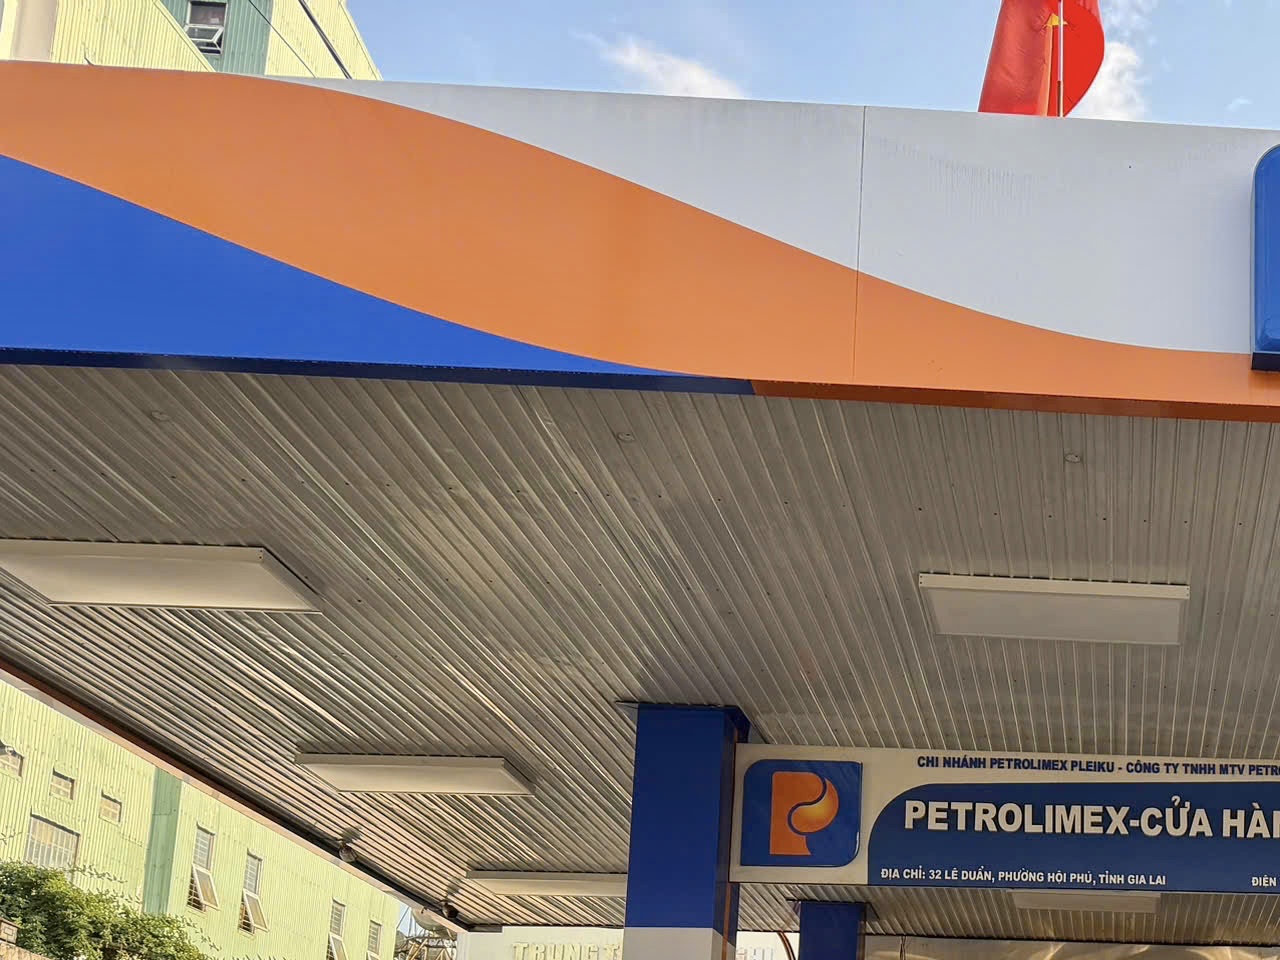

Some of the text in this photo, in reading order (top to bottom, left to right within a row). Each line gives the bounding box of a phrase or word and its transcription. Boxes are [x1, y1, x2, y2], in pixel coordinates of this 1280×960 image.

[918, 755, 939, 768] CHI
[943, 754, 986, 769] NHÁNH
[990, 758, 1067, 772] PETROLIMEX
[1071, 760, 1115, 773] PLEIKU
[1126, 759, 1160, 774] CÔNG
[1164, 763, 1179, 774] TY
[1183, 763, 1215, 775] TNHH
[1219, 764, 1245, 775] MTV
[904, 795, 1213, 838] PETROLIMEX-CỬA
[881, 865, 1166, 886] ĐỊA CHỈ: 32 LÊ DUẨN, PHƯỜNG HỘI PHÚ, TỈNH GIA LAI
[1251, 874, 1276, 888] ĐIỆN
